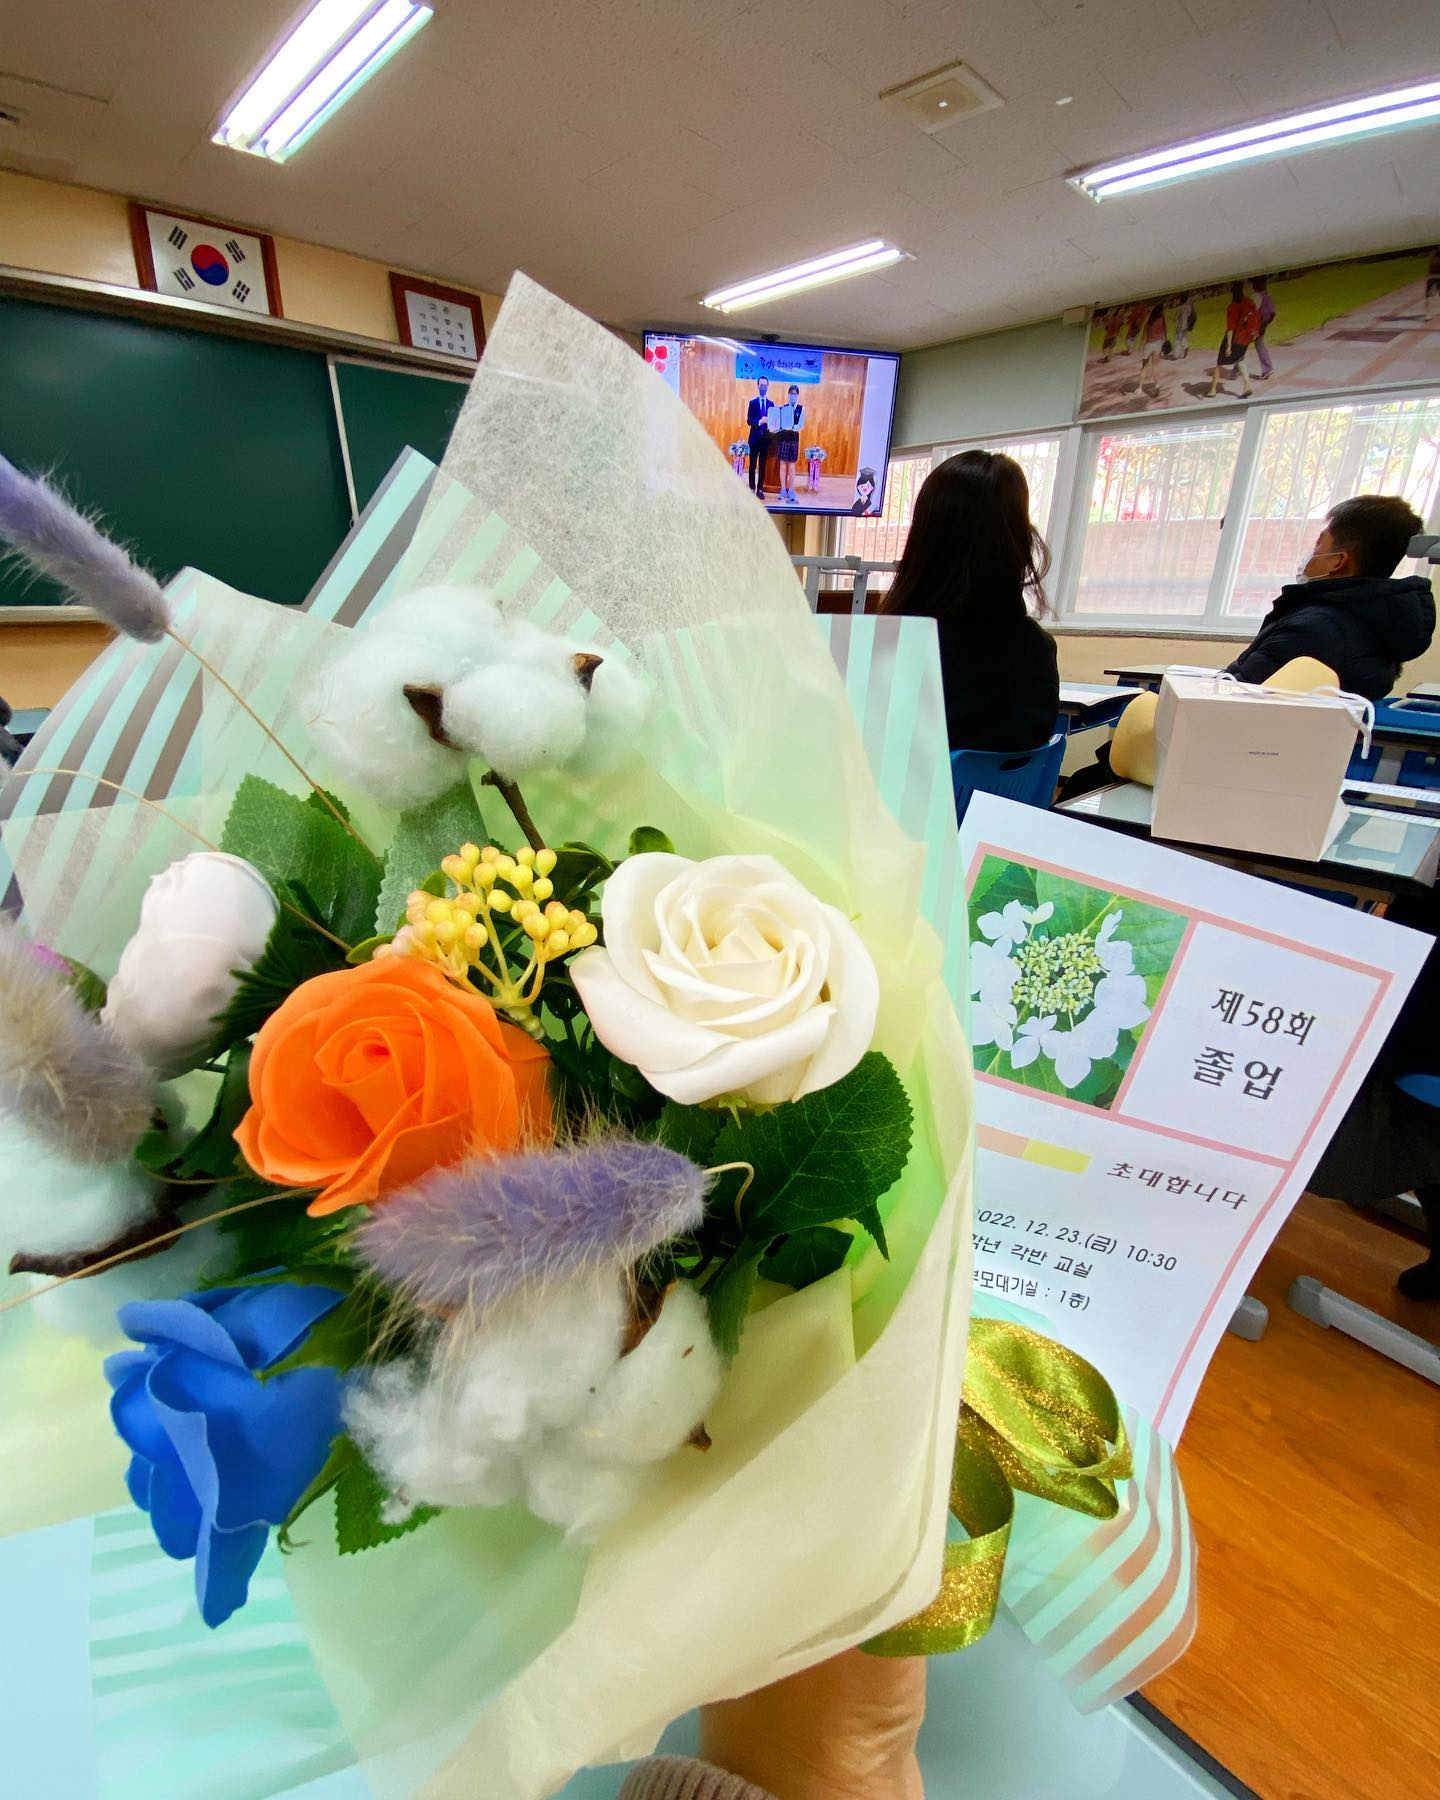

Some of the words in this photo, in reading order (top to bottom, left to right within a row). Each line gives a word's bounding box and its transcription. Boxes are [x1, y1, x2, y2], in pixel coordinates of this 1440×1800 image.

[1210, 987, 1317, 1047] 제58회
[1105, 1161, 1249, 1210] 초대합니다
[976, 1208, 1016, 1230] 022.
[1024, 1219, 1049, 1237] 12.
[1126, 1244, 1178, 1272] 10:30
[1010, 1243, 1048, 1266] 각반
[1053, 1255, 1094, 1279] 교실
